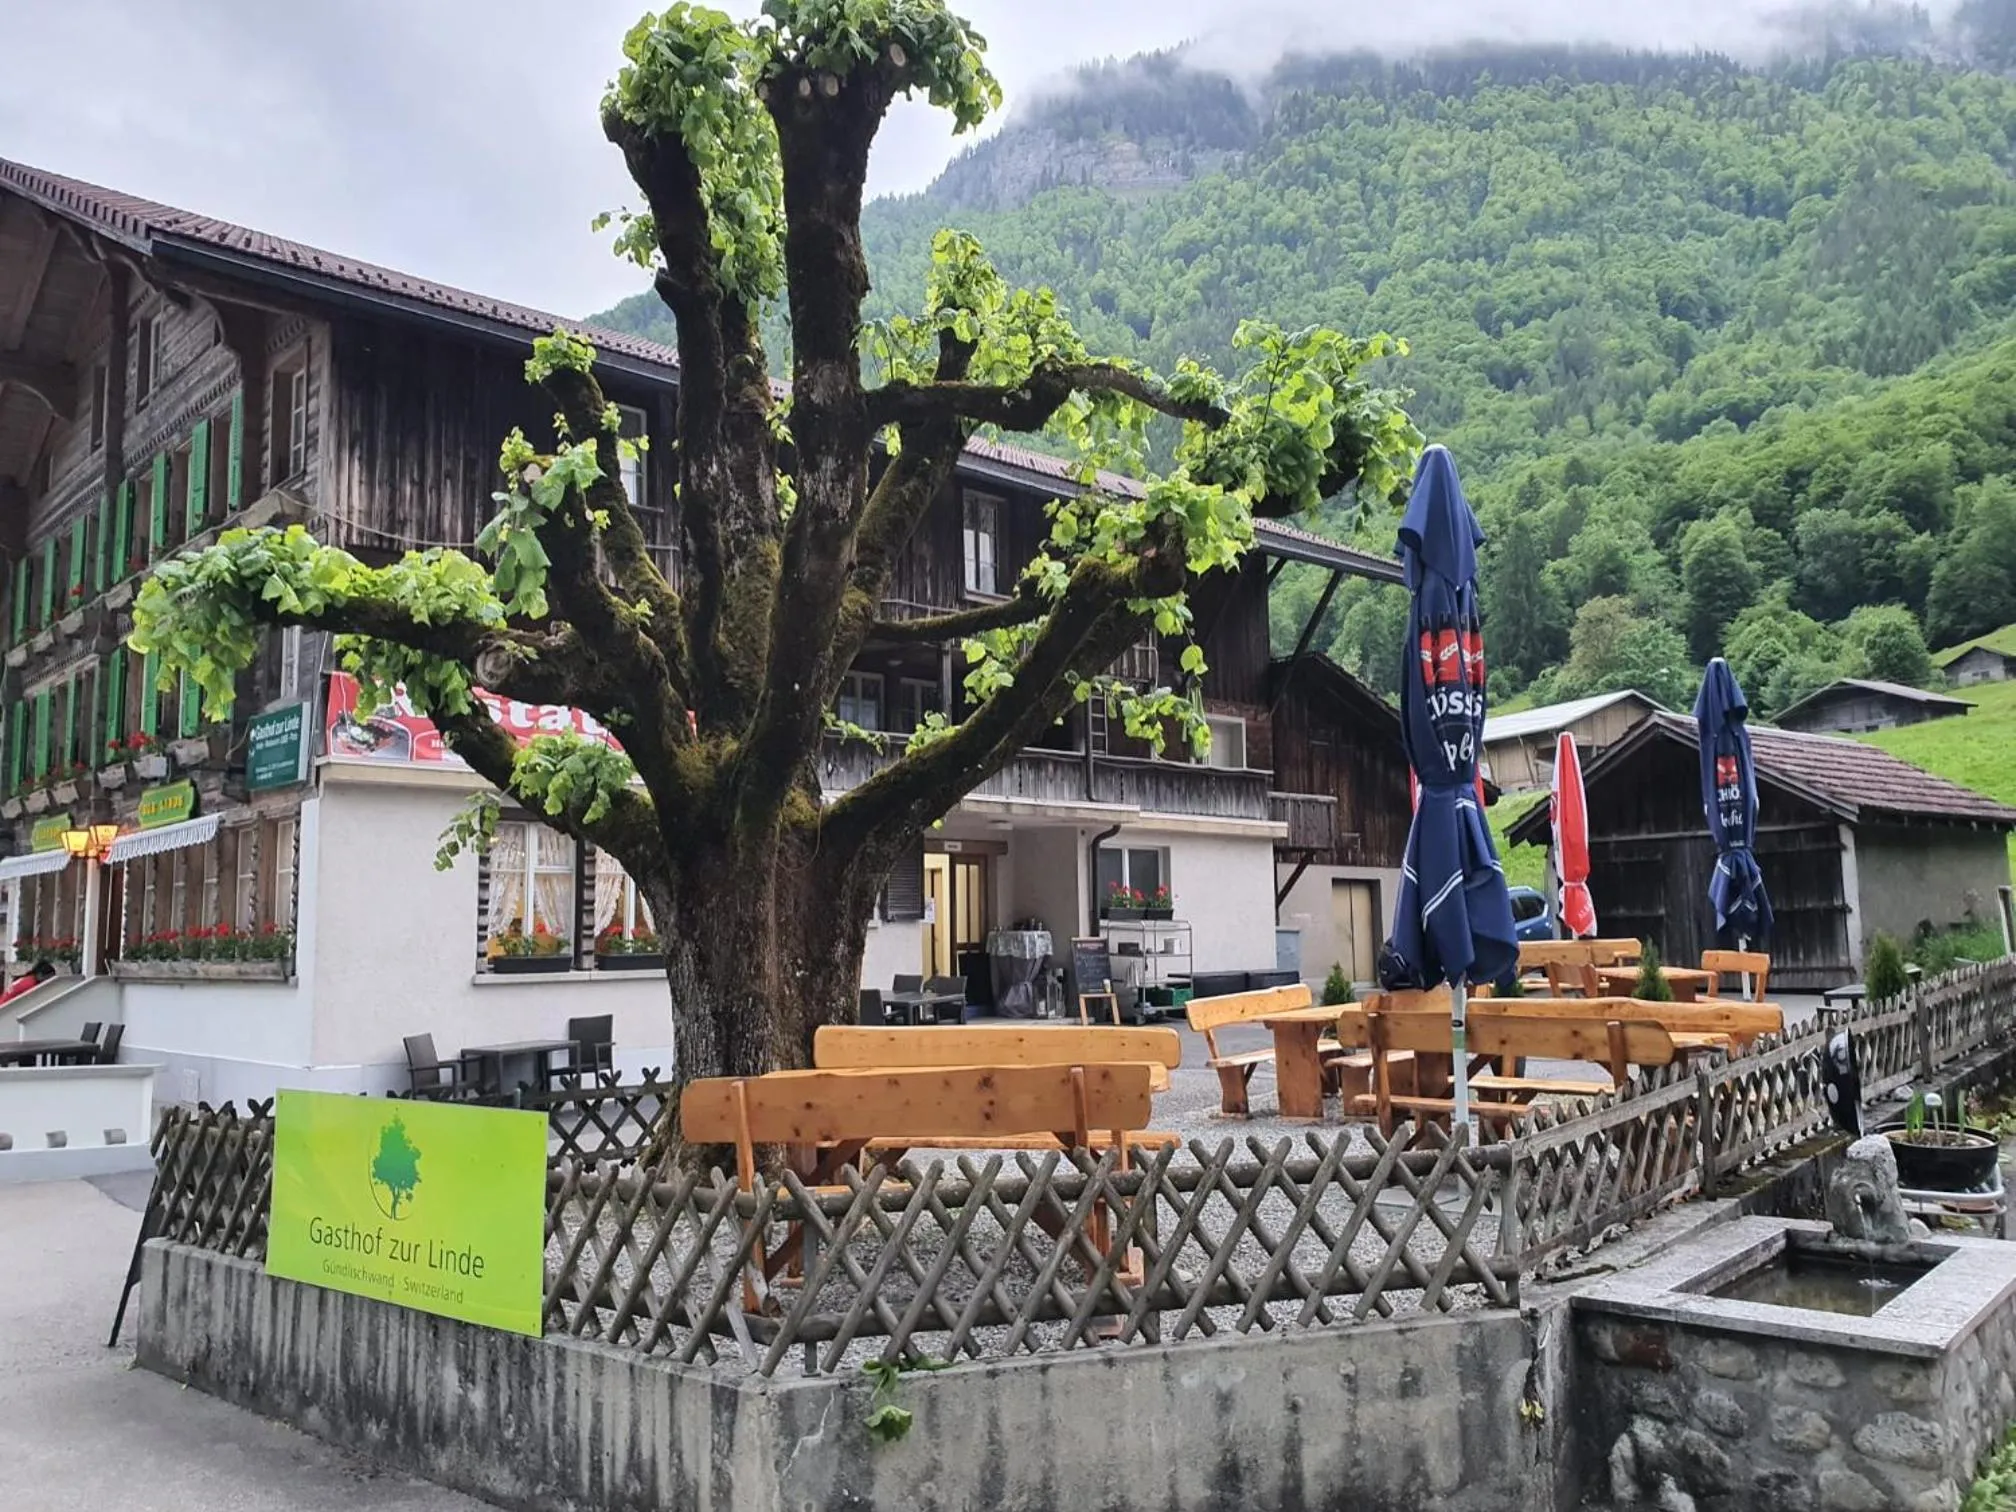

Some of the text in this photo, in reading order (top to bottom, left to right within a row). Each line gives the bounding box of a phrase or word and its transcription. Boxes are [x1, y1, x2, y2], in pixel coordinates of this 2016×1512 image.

[284, 714, 300, 733] Linde
[309, 1216, 485, 1279] Gasthof zur Linde
[322, 1259, 464, 1305] Gündlischwand Switzerland
